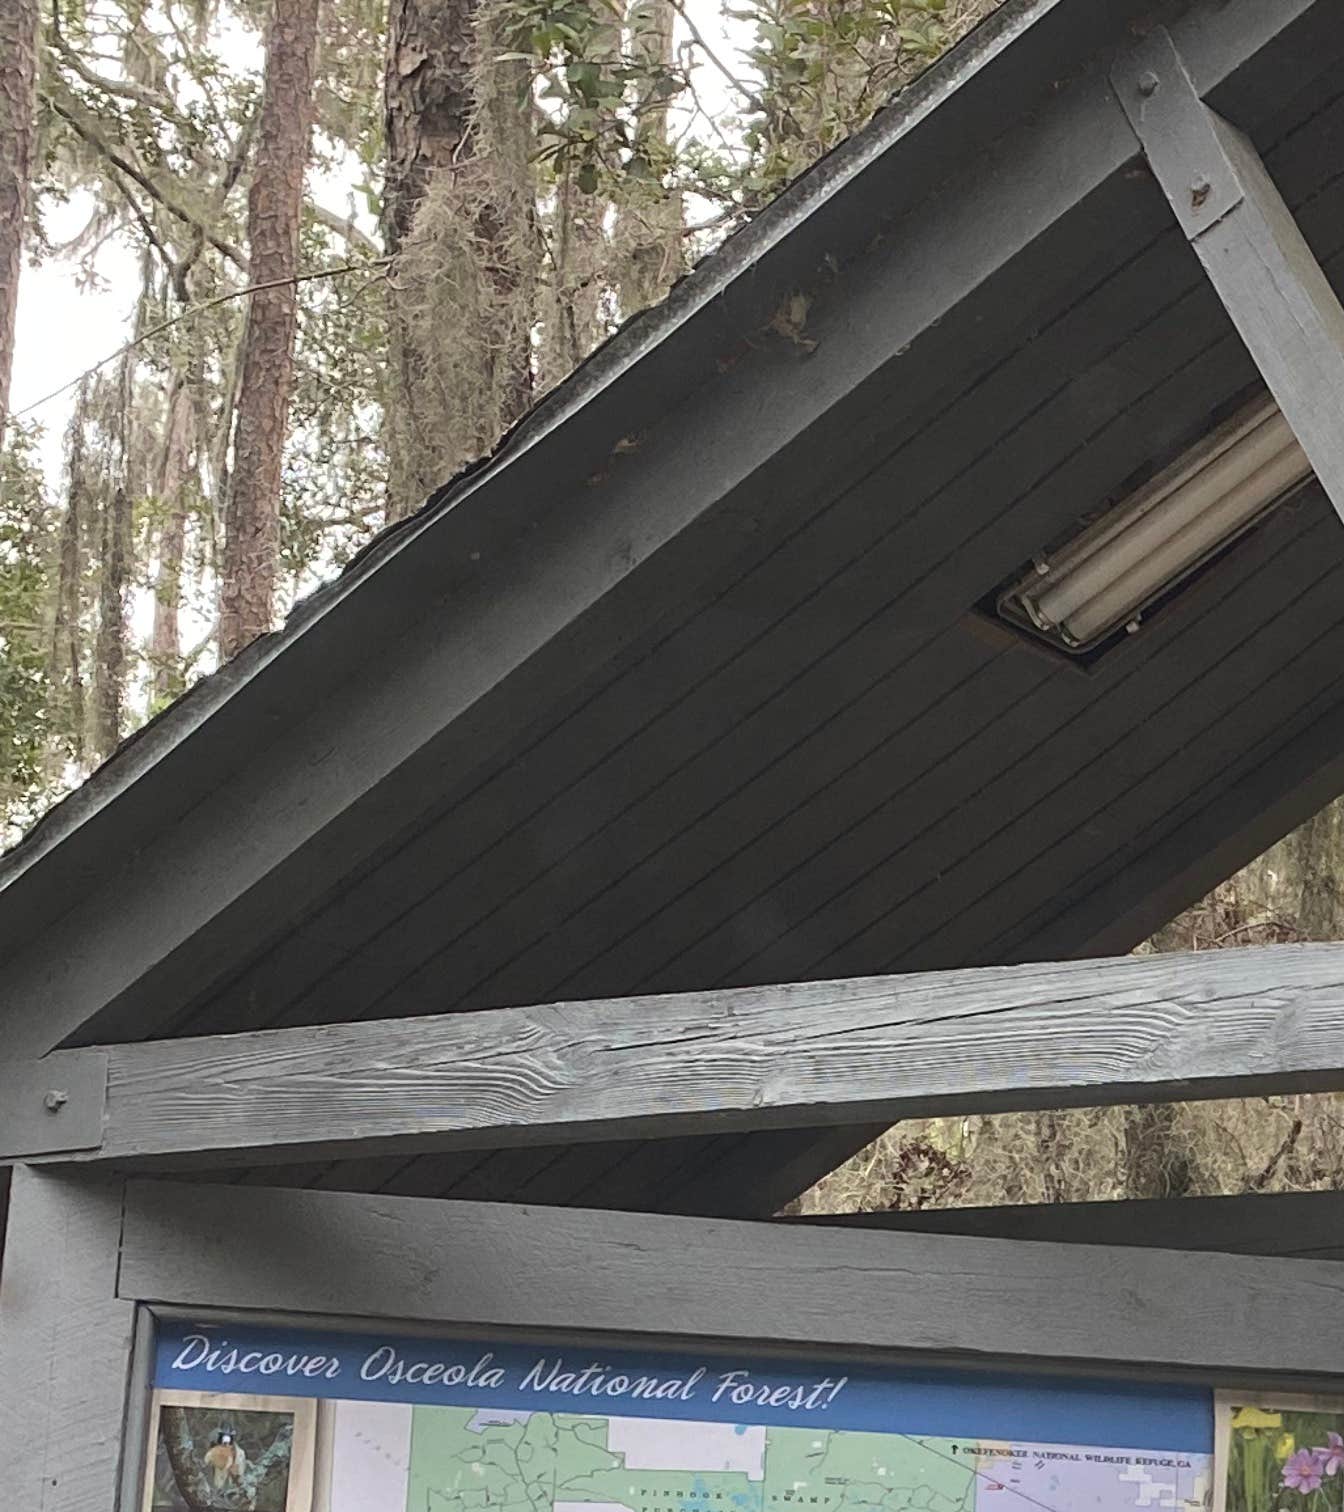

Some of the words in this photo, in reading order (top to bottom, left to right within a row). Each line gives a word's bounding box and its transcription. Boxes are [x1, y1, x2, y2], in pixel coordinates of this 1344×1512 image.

[172, 1334, 341, 1379] Discover
[359, 1345, 504, 1390] Osceola
[519, 1358, 698, 1403] National
[712, 1370, 849, 1412] Forest!
